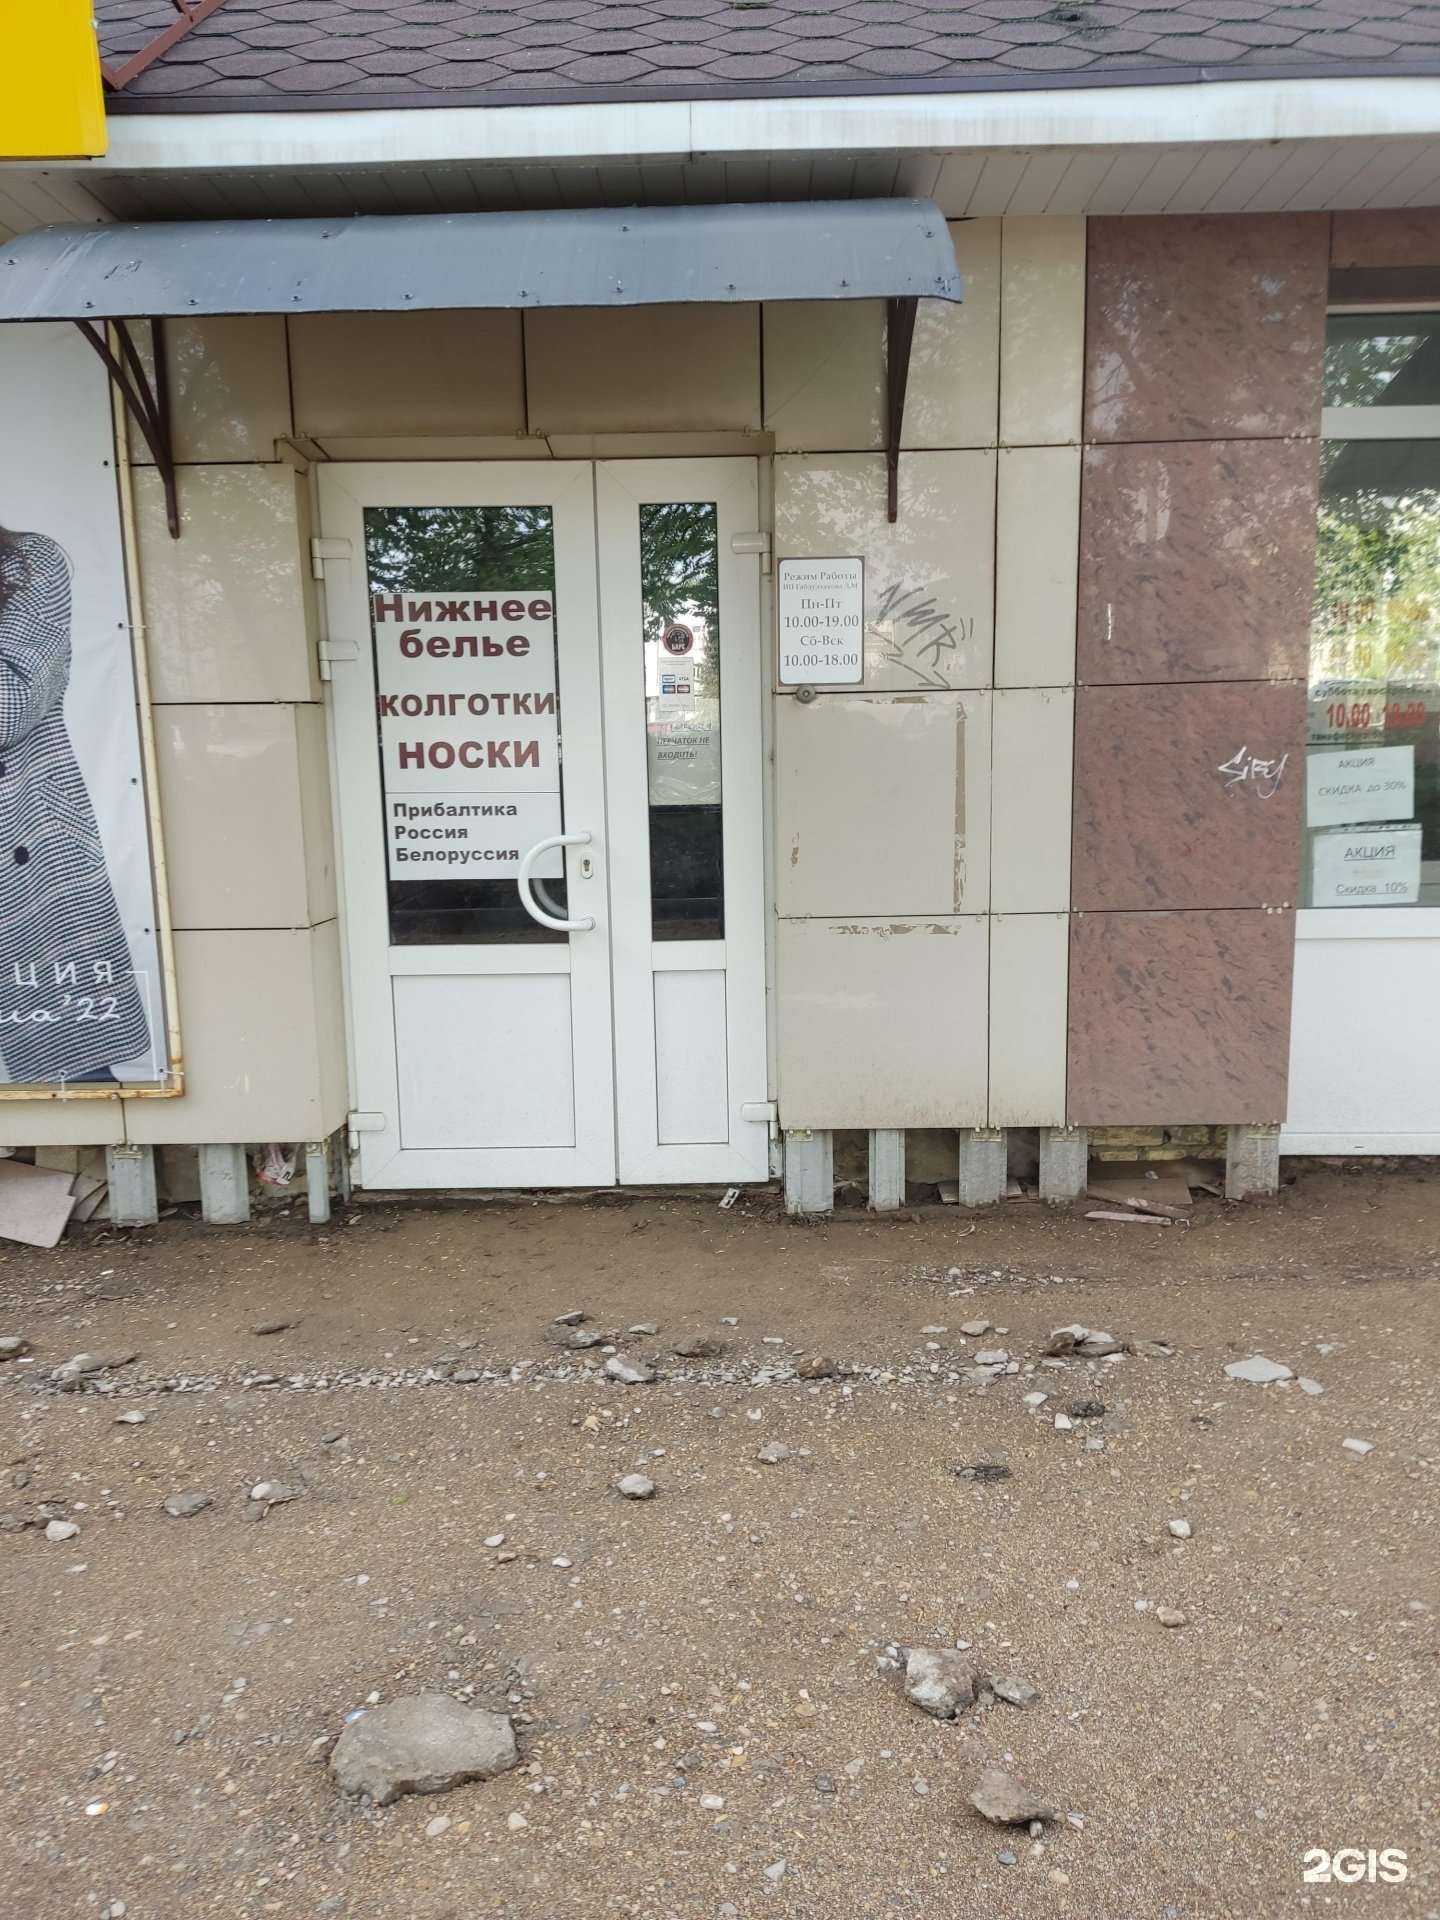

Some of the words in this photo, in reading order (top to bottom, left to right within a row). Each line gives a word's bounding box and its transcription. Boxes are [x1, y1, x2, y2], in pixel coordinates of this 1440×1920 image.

[784, 571, 817, 580] Режим
[820, 571, 857, 580] Работы
[375, 594, 552, 623] Нижнее
[801, 599, 841, 609] Пн-Пт
[785, 615, 859, 628] 10.00-19.00
[400, 628, 530, 658] белье
[800, 635, 844, 646] Сб-Вск
[785, 654, 858, 667] 10.00-18.00
[379, 693, 555, 716] колготки
[1338, 757, 1375, 768] АКЦИЯ
[394, 803, 517, 819] Прибалтика
[395, 826, 468, 840] Россия
[396, 848, 519, 864] Белоруссия
[1344, 846, 1395, 860] АКЦИЯ
